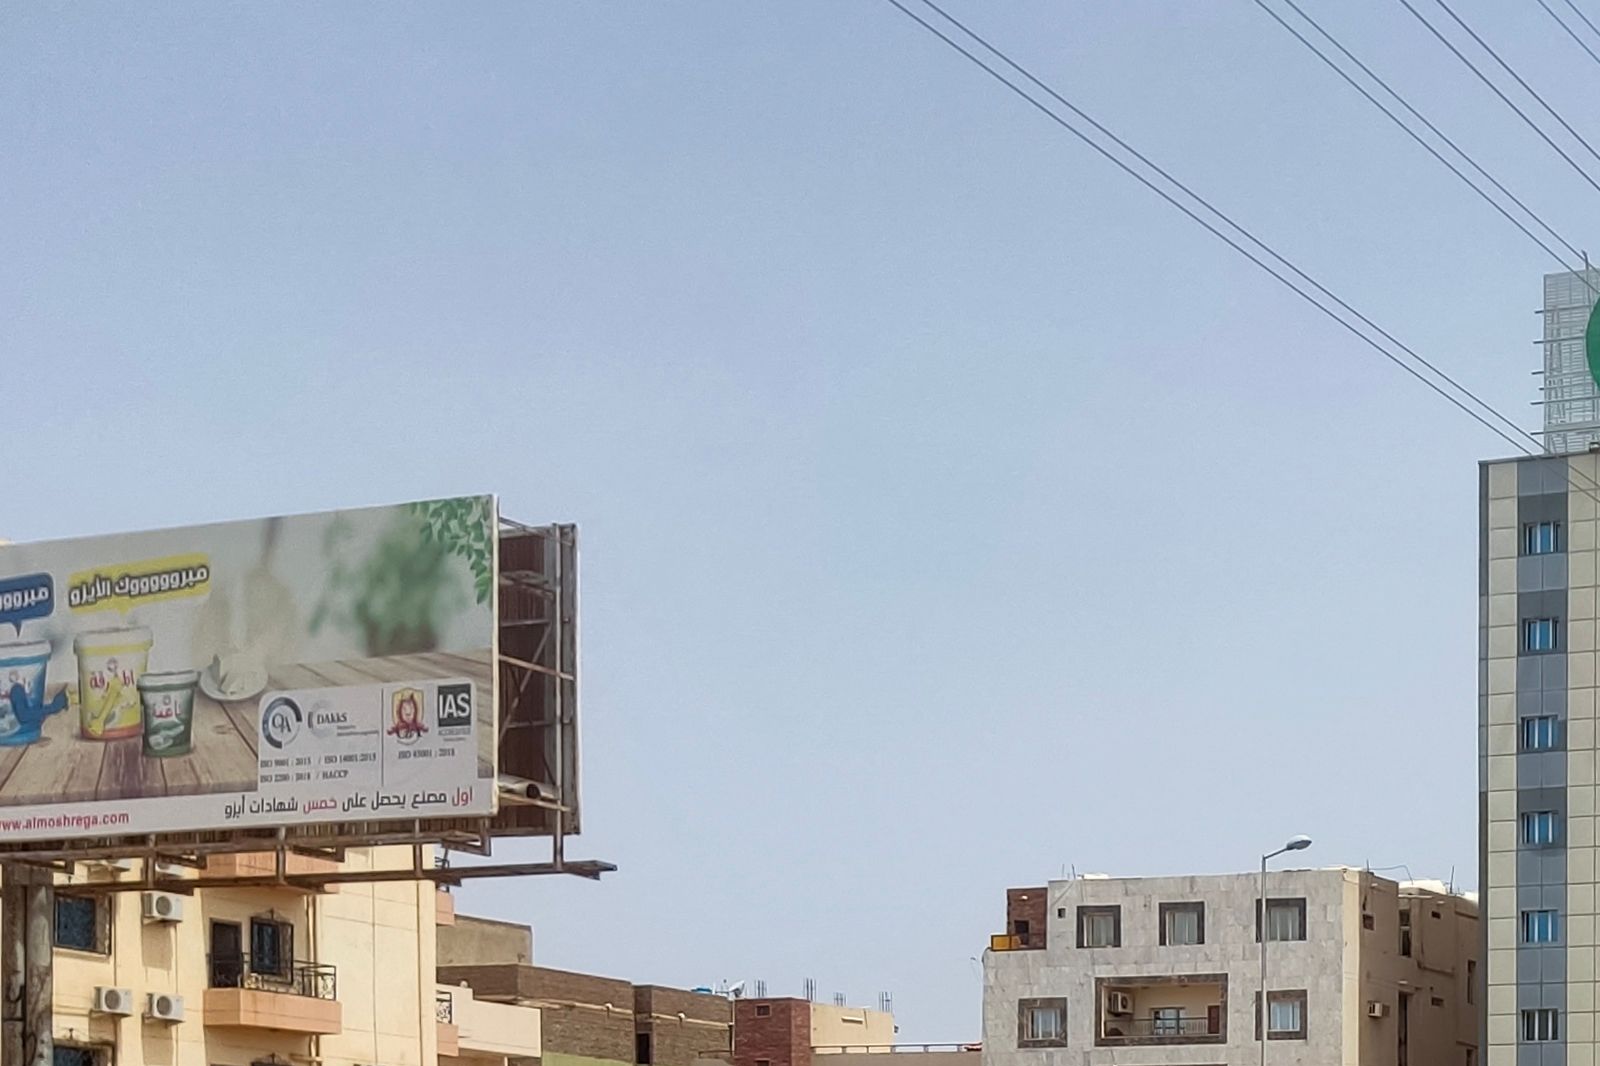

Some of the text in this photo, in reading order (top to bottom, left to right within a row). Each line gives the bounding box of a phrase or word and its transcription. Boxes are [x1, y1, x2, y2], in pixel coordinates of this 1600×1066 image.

[438, 692, 470, 719] IAS
[249, 797, 298, 814] شهادات
[302, 796, 338, 813] خمس
[342, 792, 367, 812] على
[371, 790, 406, 811] يحصل
